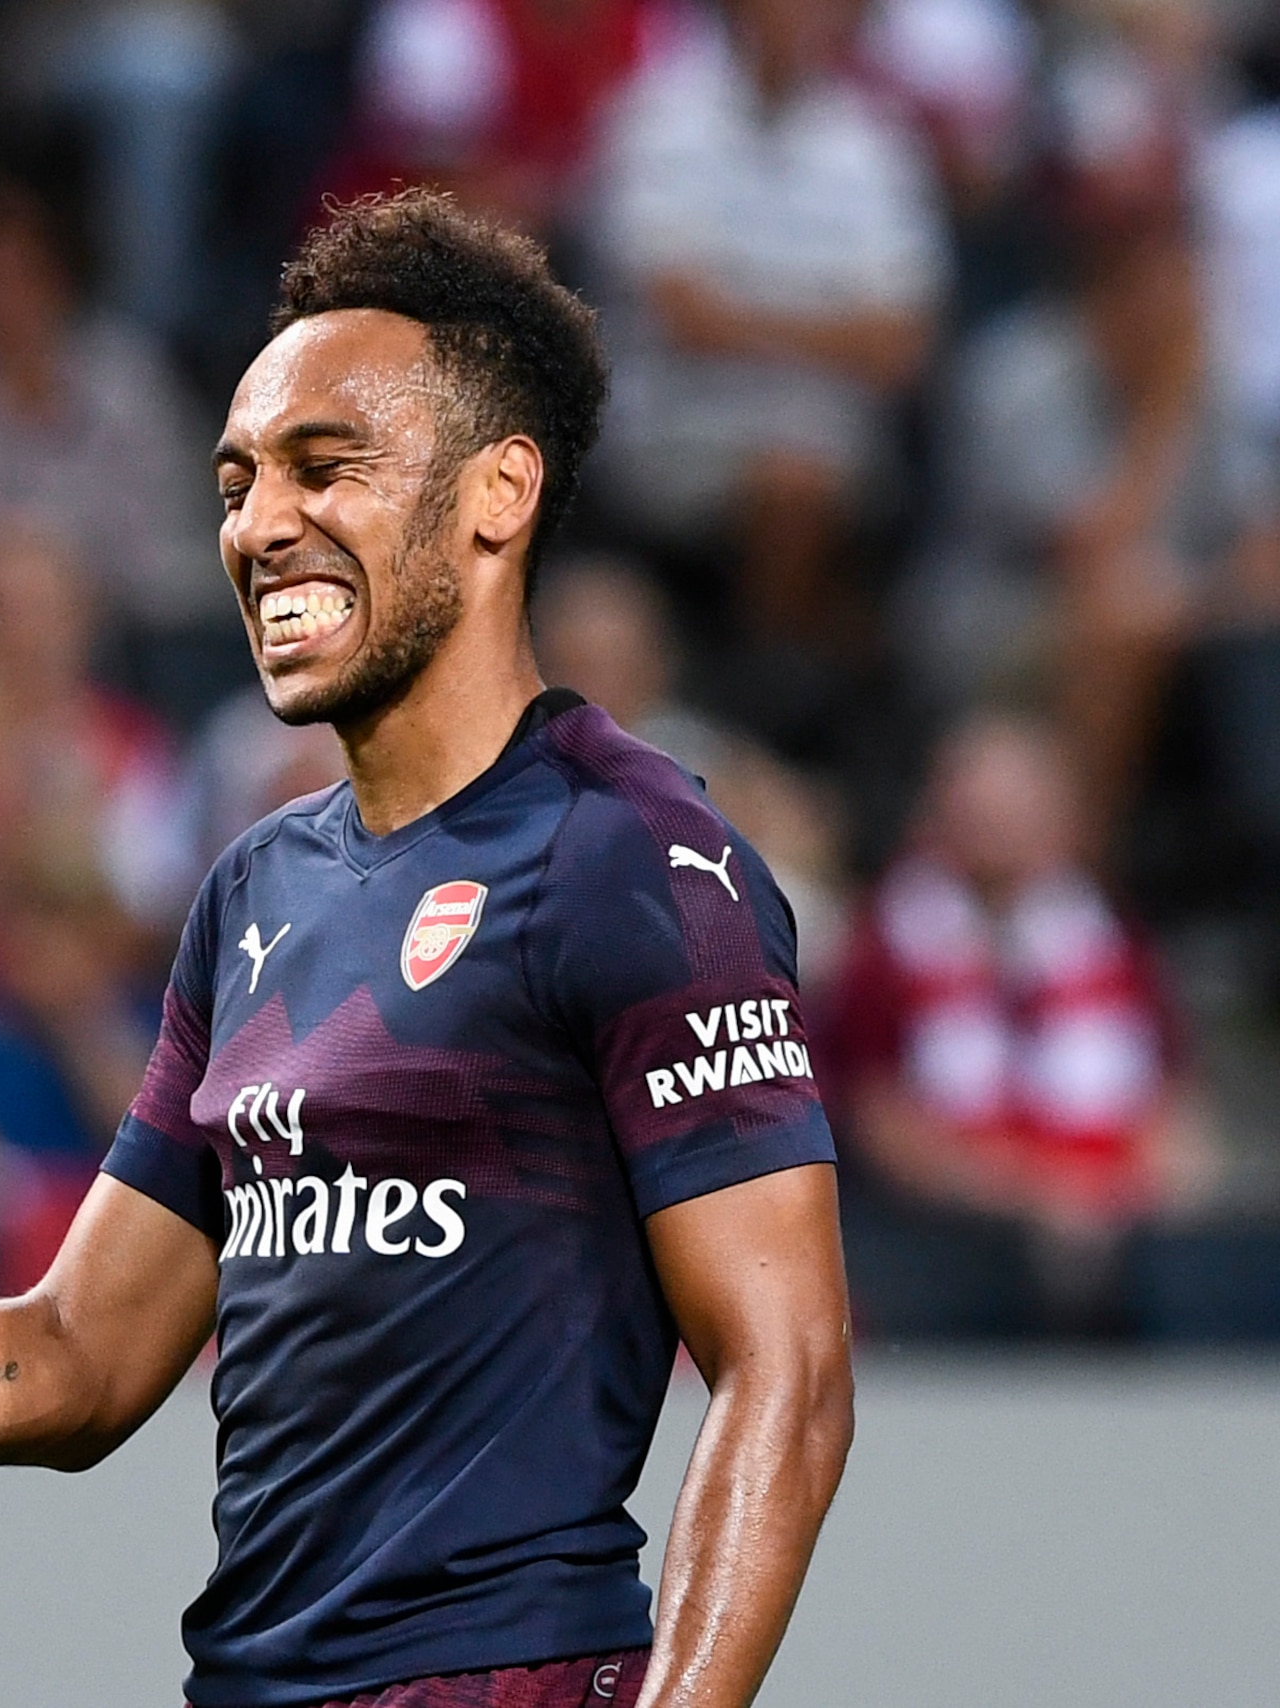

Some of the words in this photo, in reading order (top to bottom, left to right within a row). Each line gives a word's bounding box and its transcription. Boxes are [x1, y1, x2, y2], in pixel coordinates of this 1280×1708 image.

[685, 999, 790, 1048] VISIT
[227, 1082, 305, 1156] Fly
[219, 1155, 466, 1262] mirates
